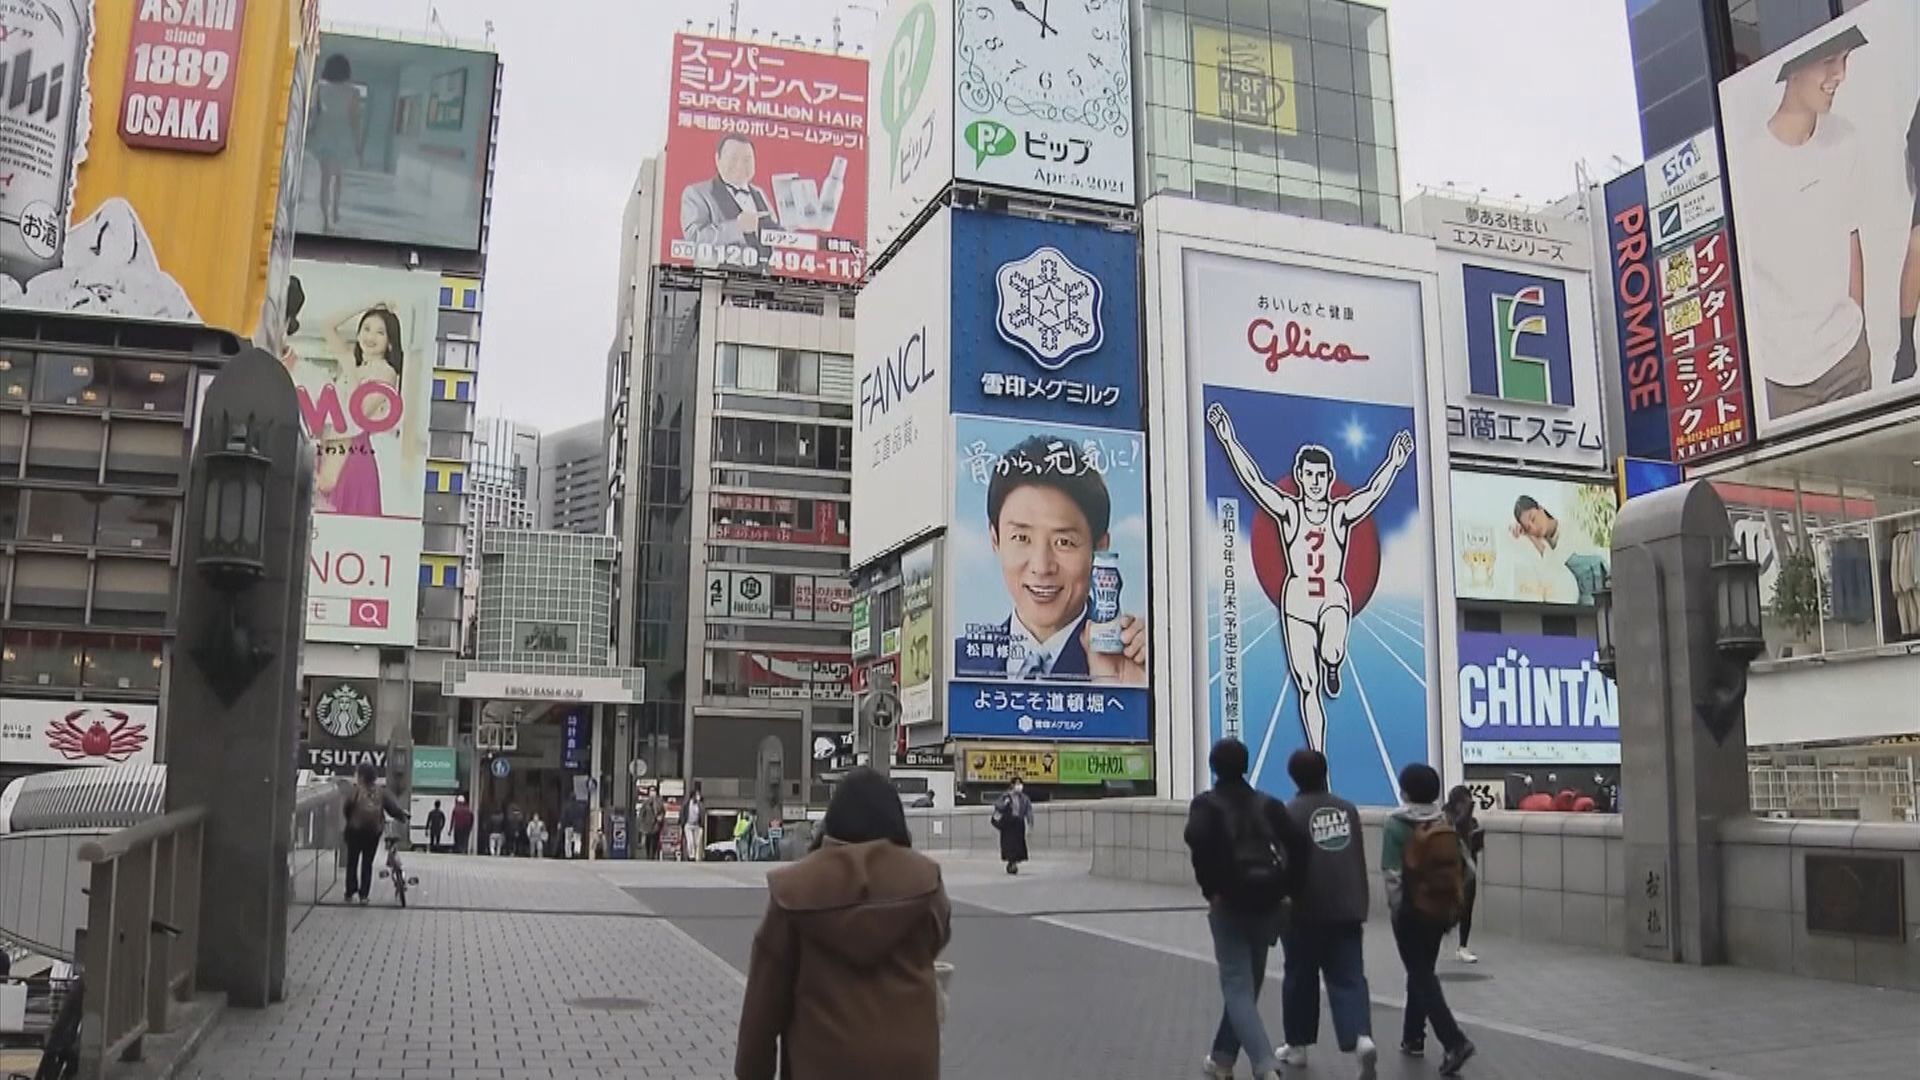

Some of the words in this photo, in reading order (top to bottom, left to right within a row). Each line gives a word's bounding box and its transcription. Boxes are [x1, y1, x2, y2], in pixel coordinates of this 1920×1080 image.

[140, 0, 236, 32] ASAHI
[164, 27, 206, 46] since
[681, 39, 785, 71] スーパー
[134, 43, 230, 90] 1889
[680, 64, 864, 104] ミリオンヘアー
[125, 93, 219, 142] OSAKA
[679, 91, 740, 111] SUPER
[746, 100, 814, 122] MILLION
[819, 111, 864, 129] HAIR
[1025, 131, 1093, 165] ピップ
[22, 212, 57, 250] お酒
[1465, 207, 1548, 234] 夢ある住まい
[1453, 229, 1564, 261] エステムシリーズ
[1257, 295, 1355, 321] おいしさと健康
[1614, 204, 1662, 411] PROMISE
[1248, 318, 1370, 373] Glico
[1697, 234, 1738, 424] インターネット
[860, 325, 935, 432] FANCL
[981, 372, 1120, 406] 雪印メグミルク
[1672, 329, 1703, 434] コミック
[1446, 405, 1603, 450] 日商エステム
[1305, 527, 1326, 597] グリコ
[1222, 503, 1239, 738] 令和3年6月末(予定)まで補修工
[974, 689, 1125, 714] ようこそ道頓堀へ
[308, 749, 388, 767] TSUTAY
